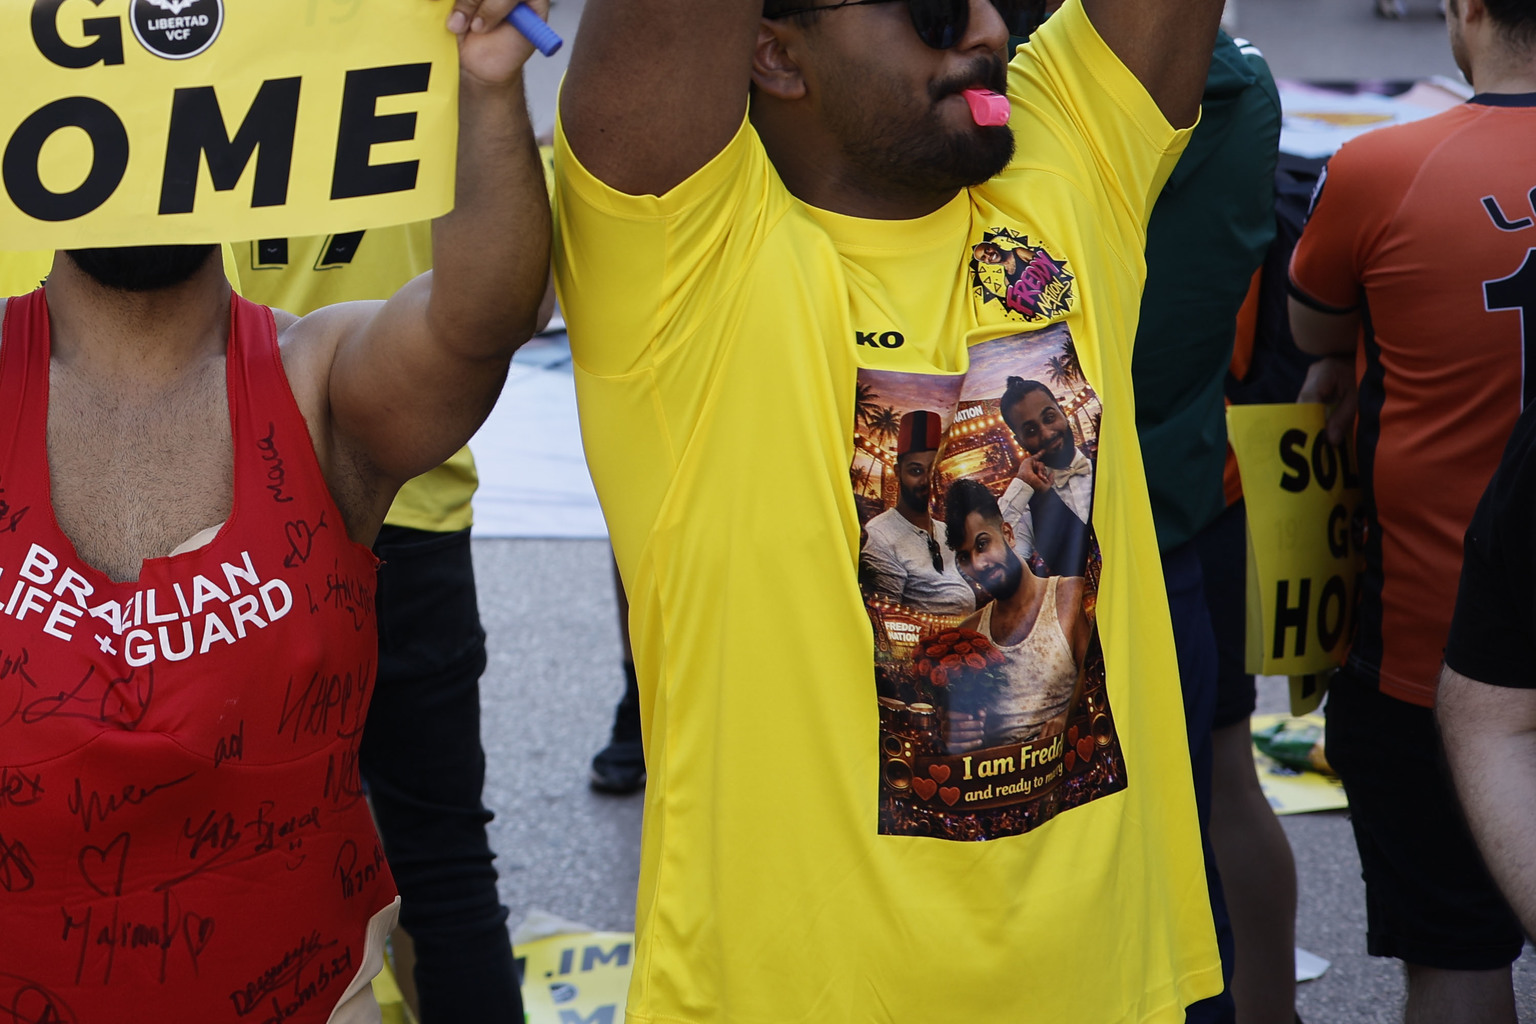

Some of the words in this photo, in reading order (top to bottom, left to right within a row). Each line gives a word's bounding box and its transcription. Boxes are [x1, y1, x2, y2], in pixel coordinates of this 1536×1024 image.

[148, 15, 209, 31] LIBERTAD
[166, 29, 190, 41] VCF
[123, 577, 293, 667] GUARD
[885, 621, 922, 633] FREDDY
[888, 631, 920, 642] NATION
[962, 756, 973, 780] I
[977, 756, 1015, 778] am
[964, 784, 993, 802] and
[996, 777, 1031, 796] ready
[1033, 776, 1044, 788] to
